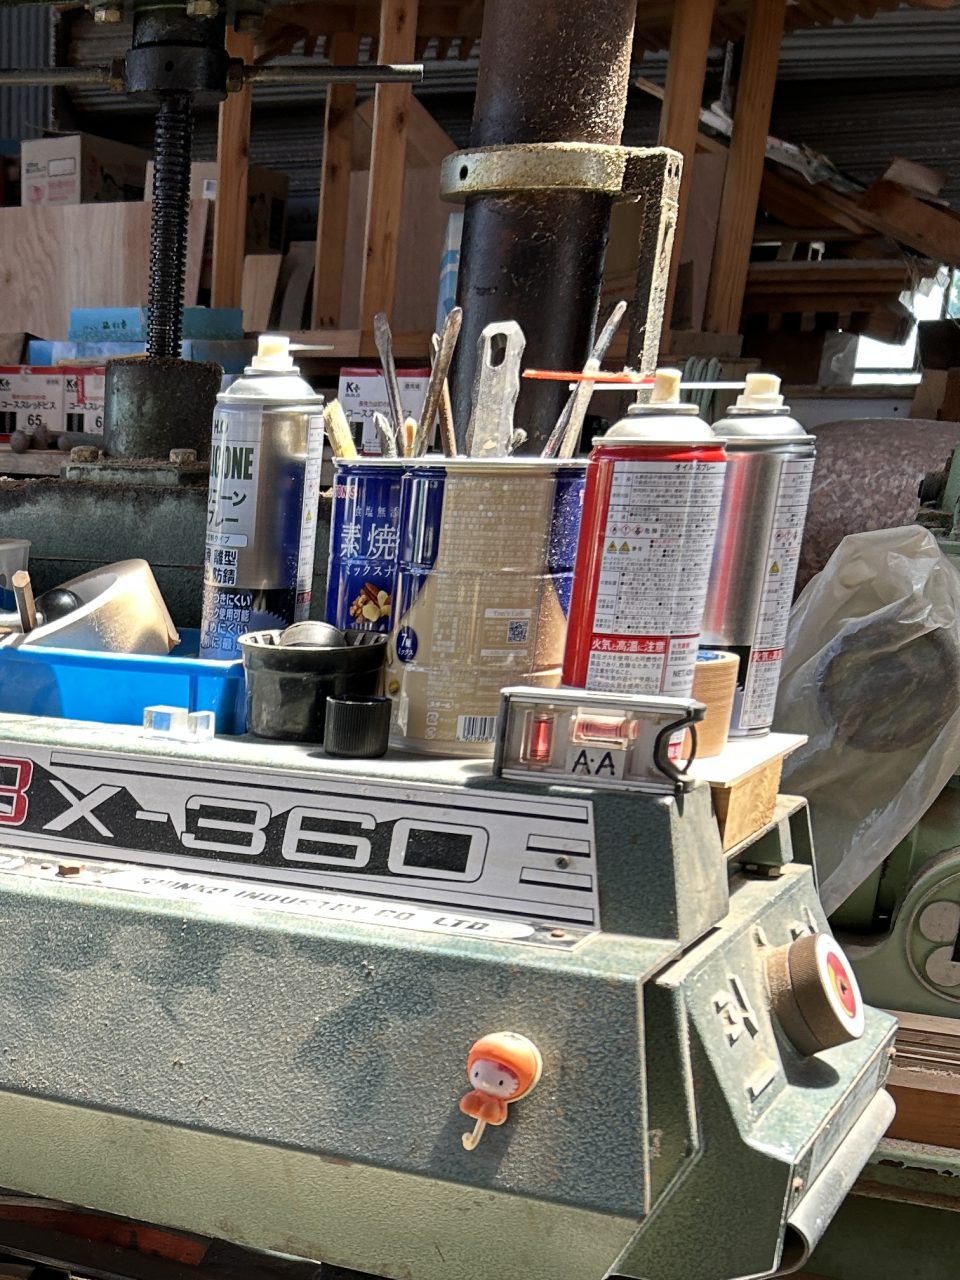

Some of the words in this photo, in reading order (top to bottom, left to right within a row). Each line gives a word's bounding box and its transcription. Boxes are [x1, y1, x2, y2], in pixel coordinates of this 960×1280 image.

[27, 414, 43, 427] 65
[591, 638, 666, 652] 火気と高温に注意
